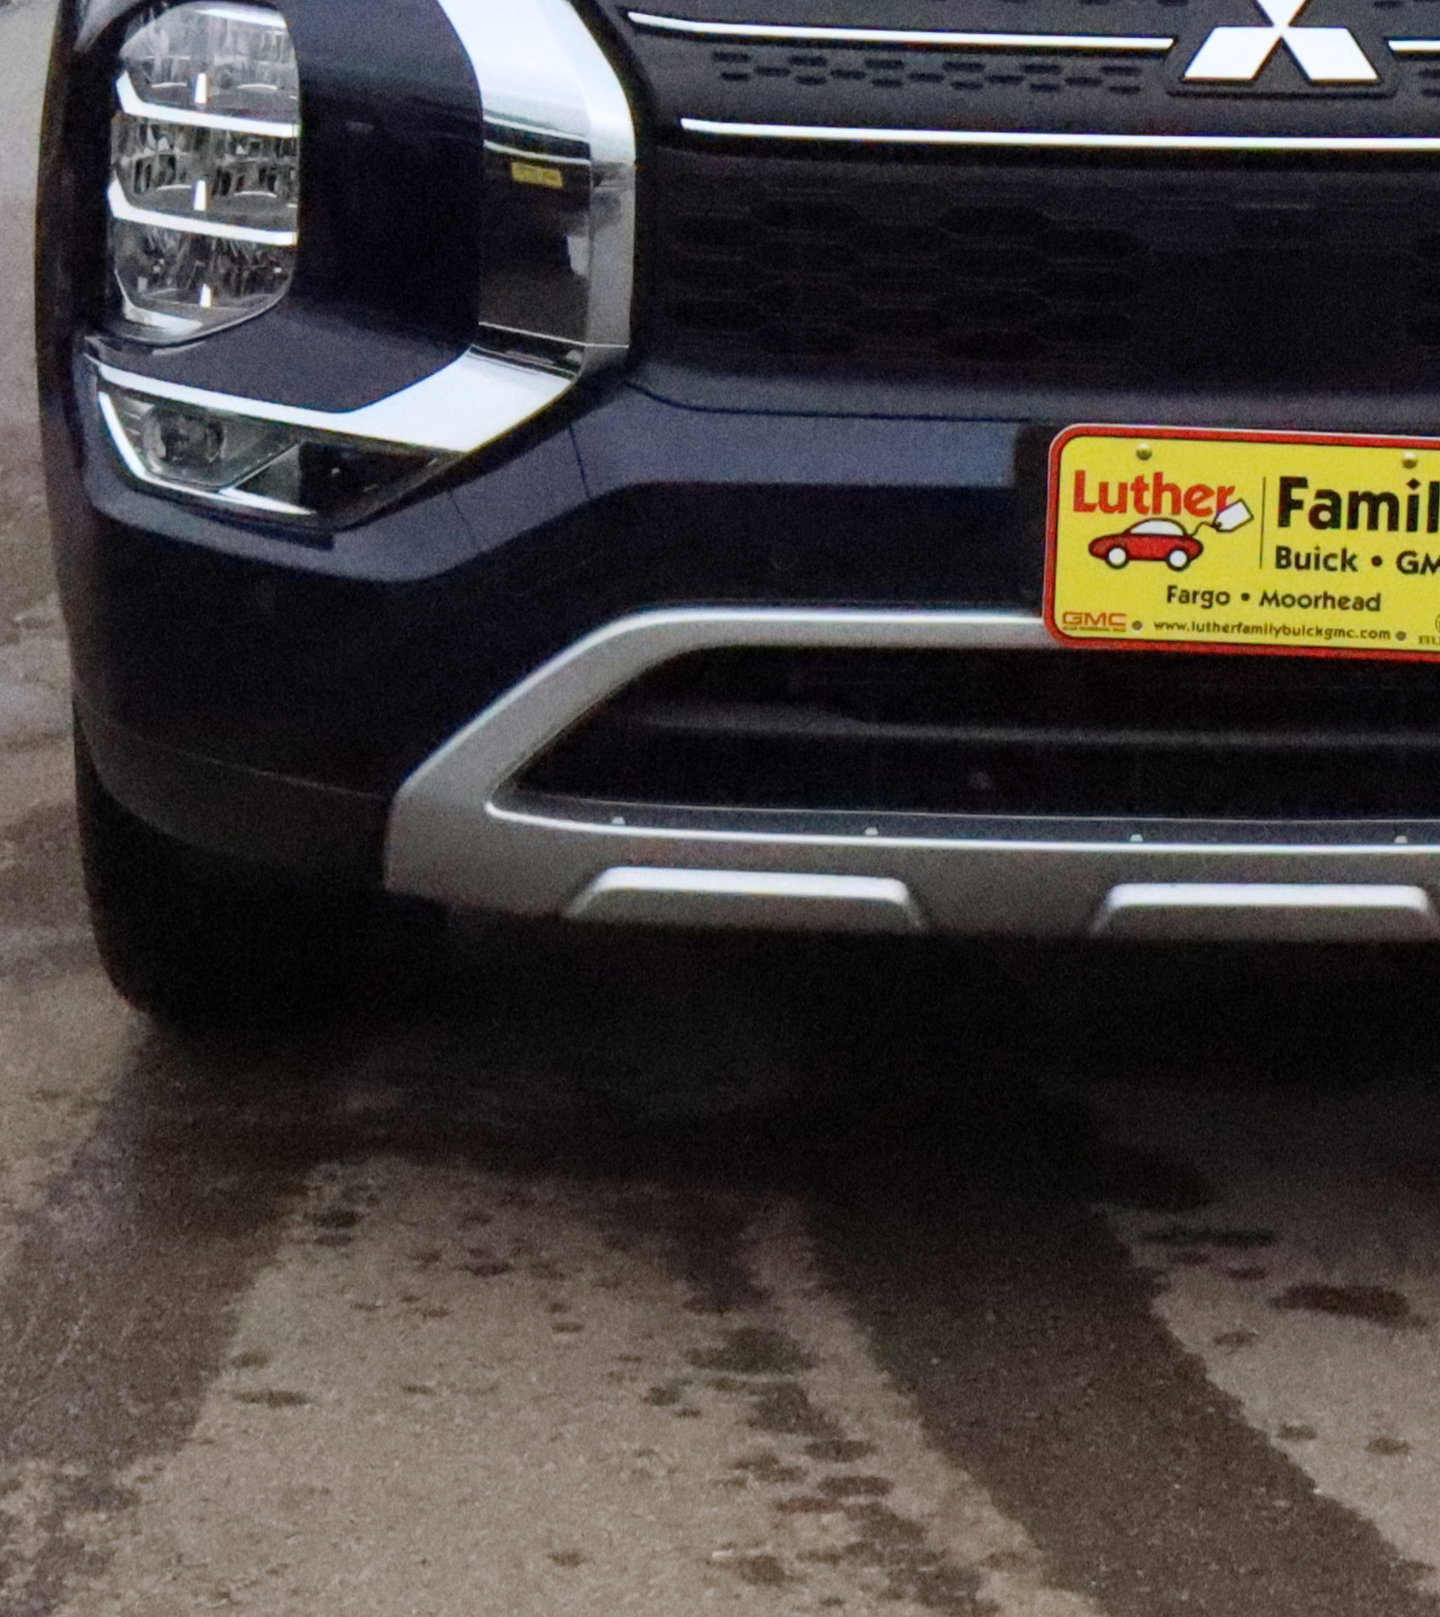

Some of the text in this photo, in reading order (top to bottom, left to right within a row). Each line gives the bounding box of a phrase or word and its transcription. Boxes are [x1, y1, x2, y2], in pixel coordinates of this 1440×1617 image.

[1072, 469, 1237, 518] Luther
[1275, 545, 1359, 572] Buick
[1166, 584, 1382, 612] Fargo Moorhead
[1062, 611, 1128, 626] GMC
[1153, 620, 1391, 641] www.lutherfamilybuickgmc.com
